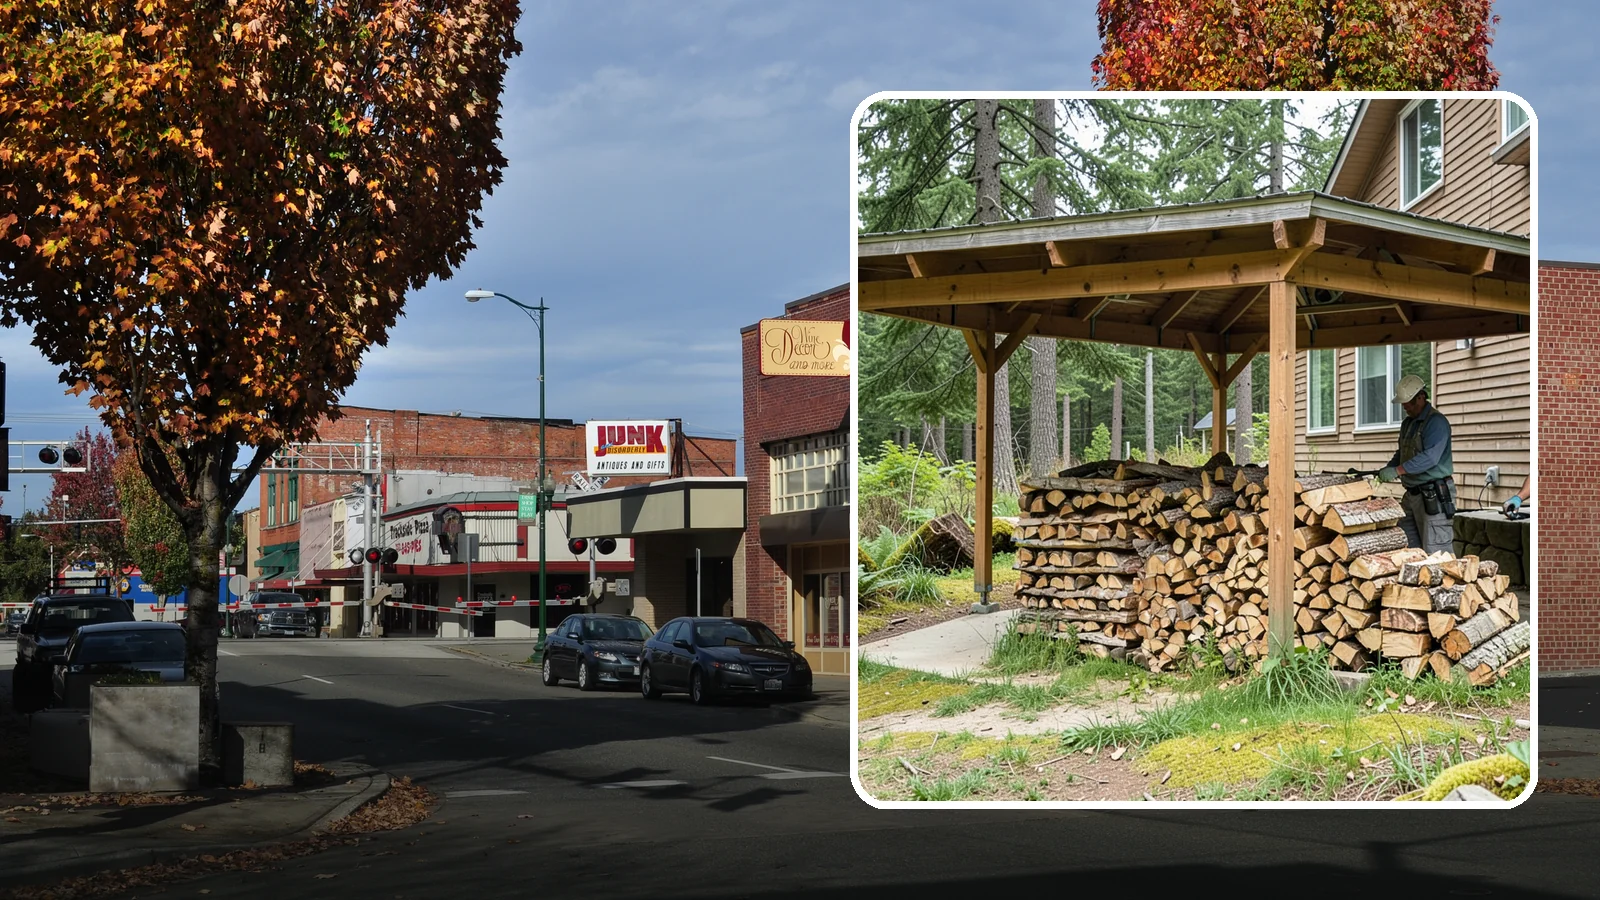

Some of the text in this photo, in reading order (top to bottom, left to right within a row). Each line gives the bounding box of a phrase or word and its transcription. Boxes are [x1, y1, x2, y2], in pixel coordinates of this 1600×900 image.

[765, 328, 831, 365] Decor
[595, 425, 664, 457] JUNK
[607, 446, 645, 454] DISORDERLY
[597, 461, 665, 470] ANTIQUES AND GIFTS
[414, 519, 429, 535] Pizza
